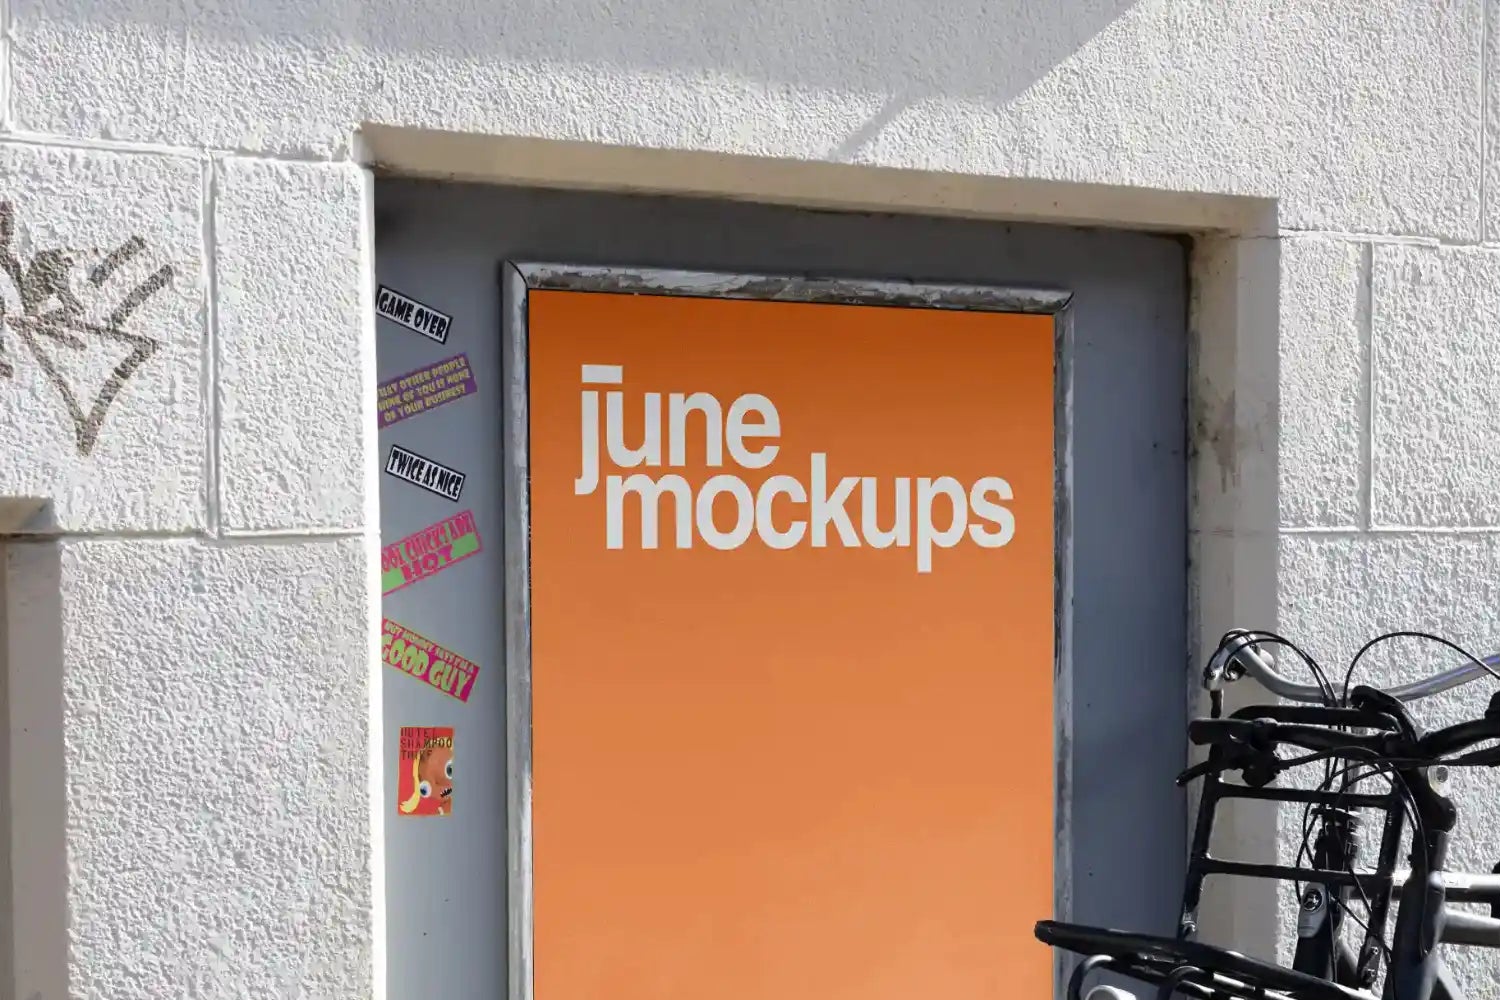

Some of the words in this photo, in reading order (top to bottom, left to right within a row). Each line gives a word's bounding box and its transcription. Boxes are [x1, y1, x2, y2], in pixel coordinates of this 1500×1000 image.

[379, 292, 414, 323] GAME
[414, 308, 447, 339] OVER
[575, 364, 781, 495] june
[390, 449, 426, 481] TWICE
[422, 464, 439, 487] AS
[436, 469, 462, 498] NICE
[606, 452, 1015, 573] mockups
[381, 633, 429, 676] GOOD
[429, 660, 472, 697] GUY
[400, 737, 453, 749] SHAMPOO
